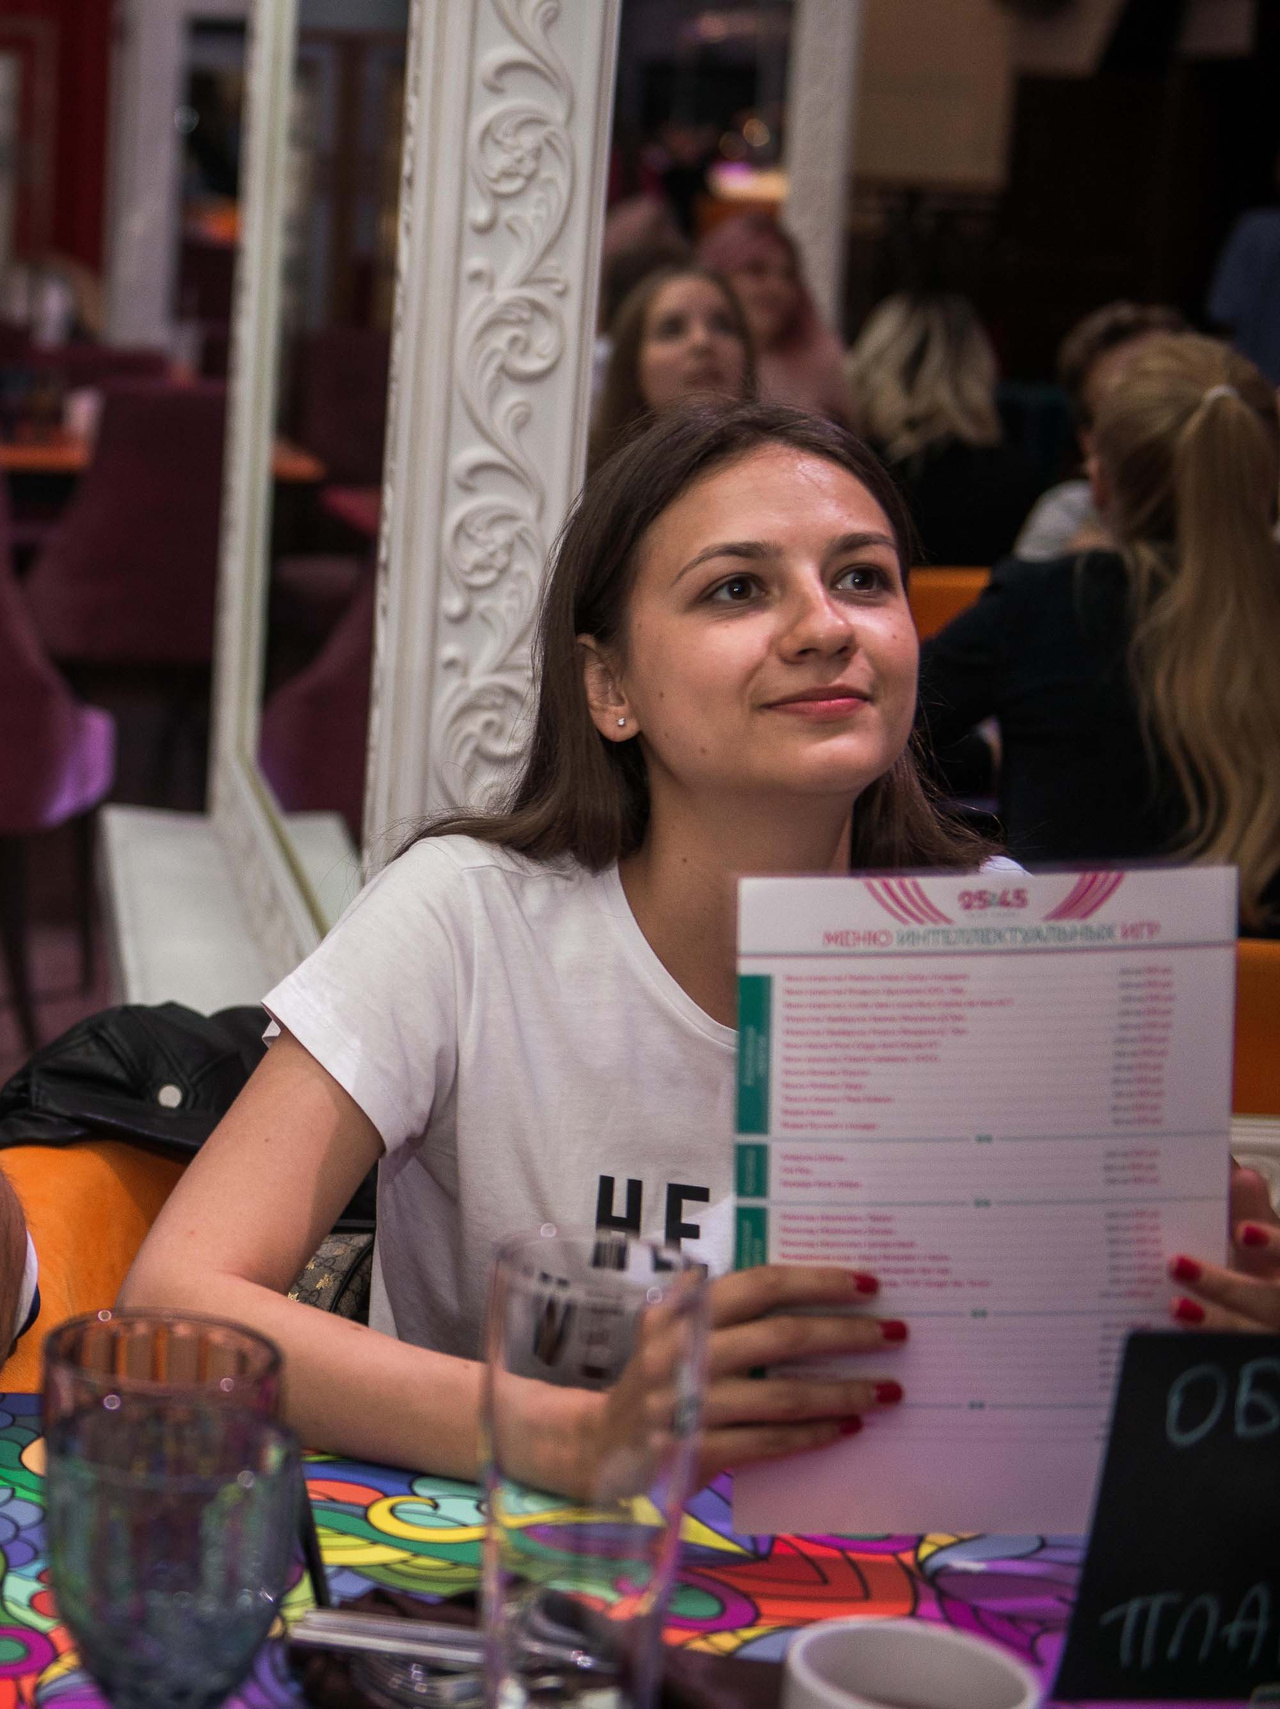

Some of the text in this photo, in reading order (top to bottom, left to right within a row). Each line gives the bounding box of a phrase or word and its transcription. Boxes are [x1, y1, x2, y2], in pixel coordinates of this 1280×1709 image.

[823, 921, 1161, 948] МЕНЮ ИНТЕЛЛЕКТУАЛЬНЫХ ИГР
[1099, 1581, 1280, 1671] ПЛА
